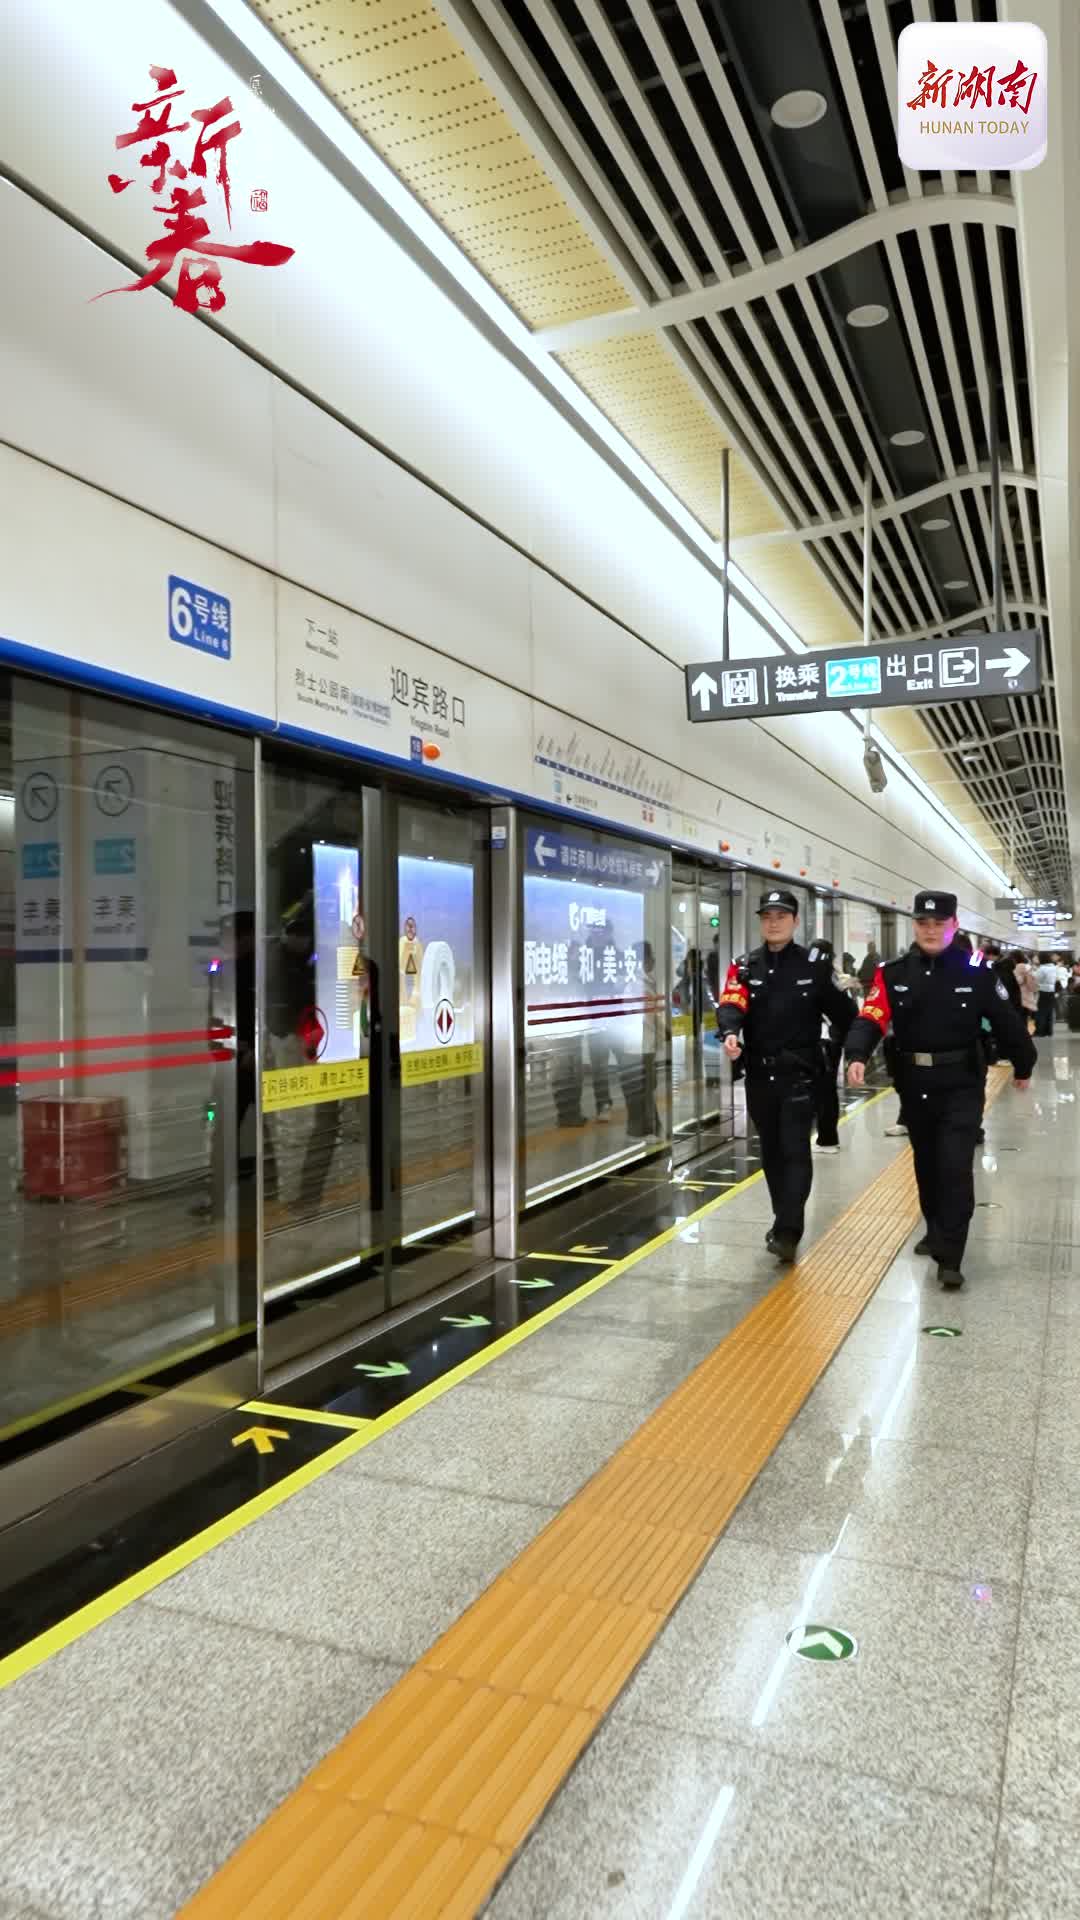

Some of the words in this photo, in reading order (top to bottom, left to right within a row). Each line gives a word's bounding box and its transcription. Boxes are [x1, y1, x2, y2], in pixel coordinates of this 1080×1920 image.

[172, 587, 228, 633] 6号线
[194, 627, 219, 648] Line
[775, 663, 820, 688] 换乘
[830, 662, 877, 691] 2号线
[887, 653, 933, 677] 出口
[391, 665, 465, 728] 迎宾路口
[906, 678, 933, 691] Exit
